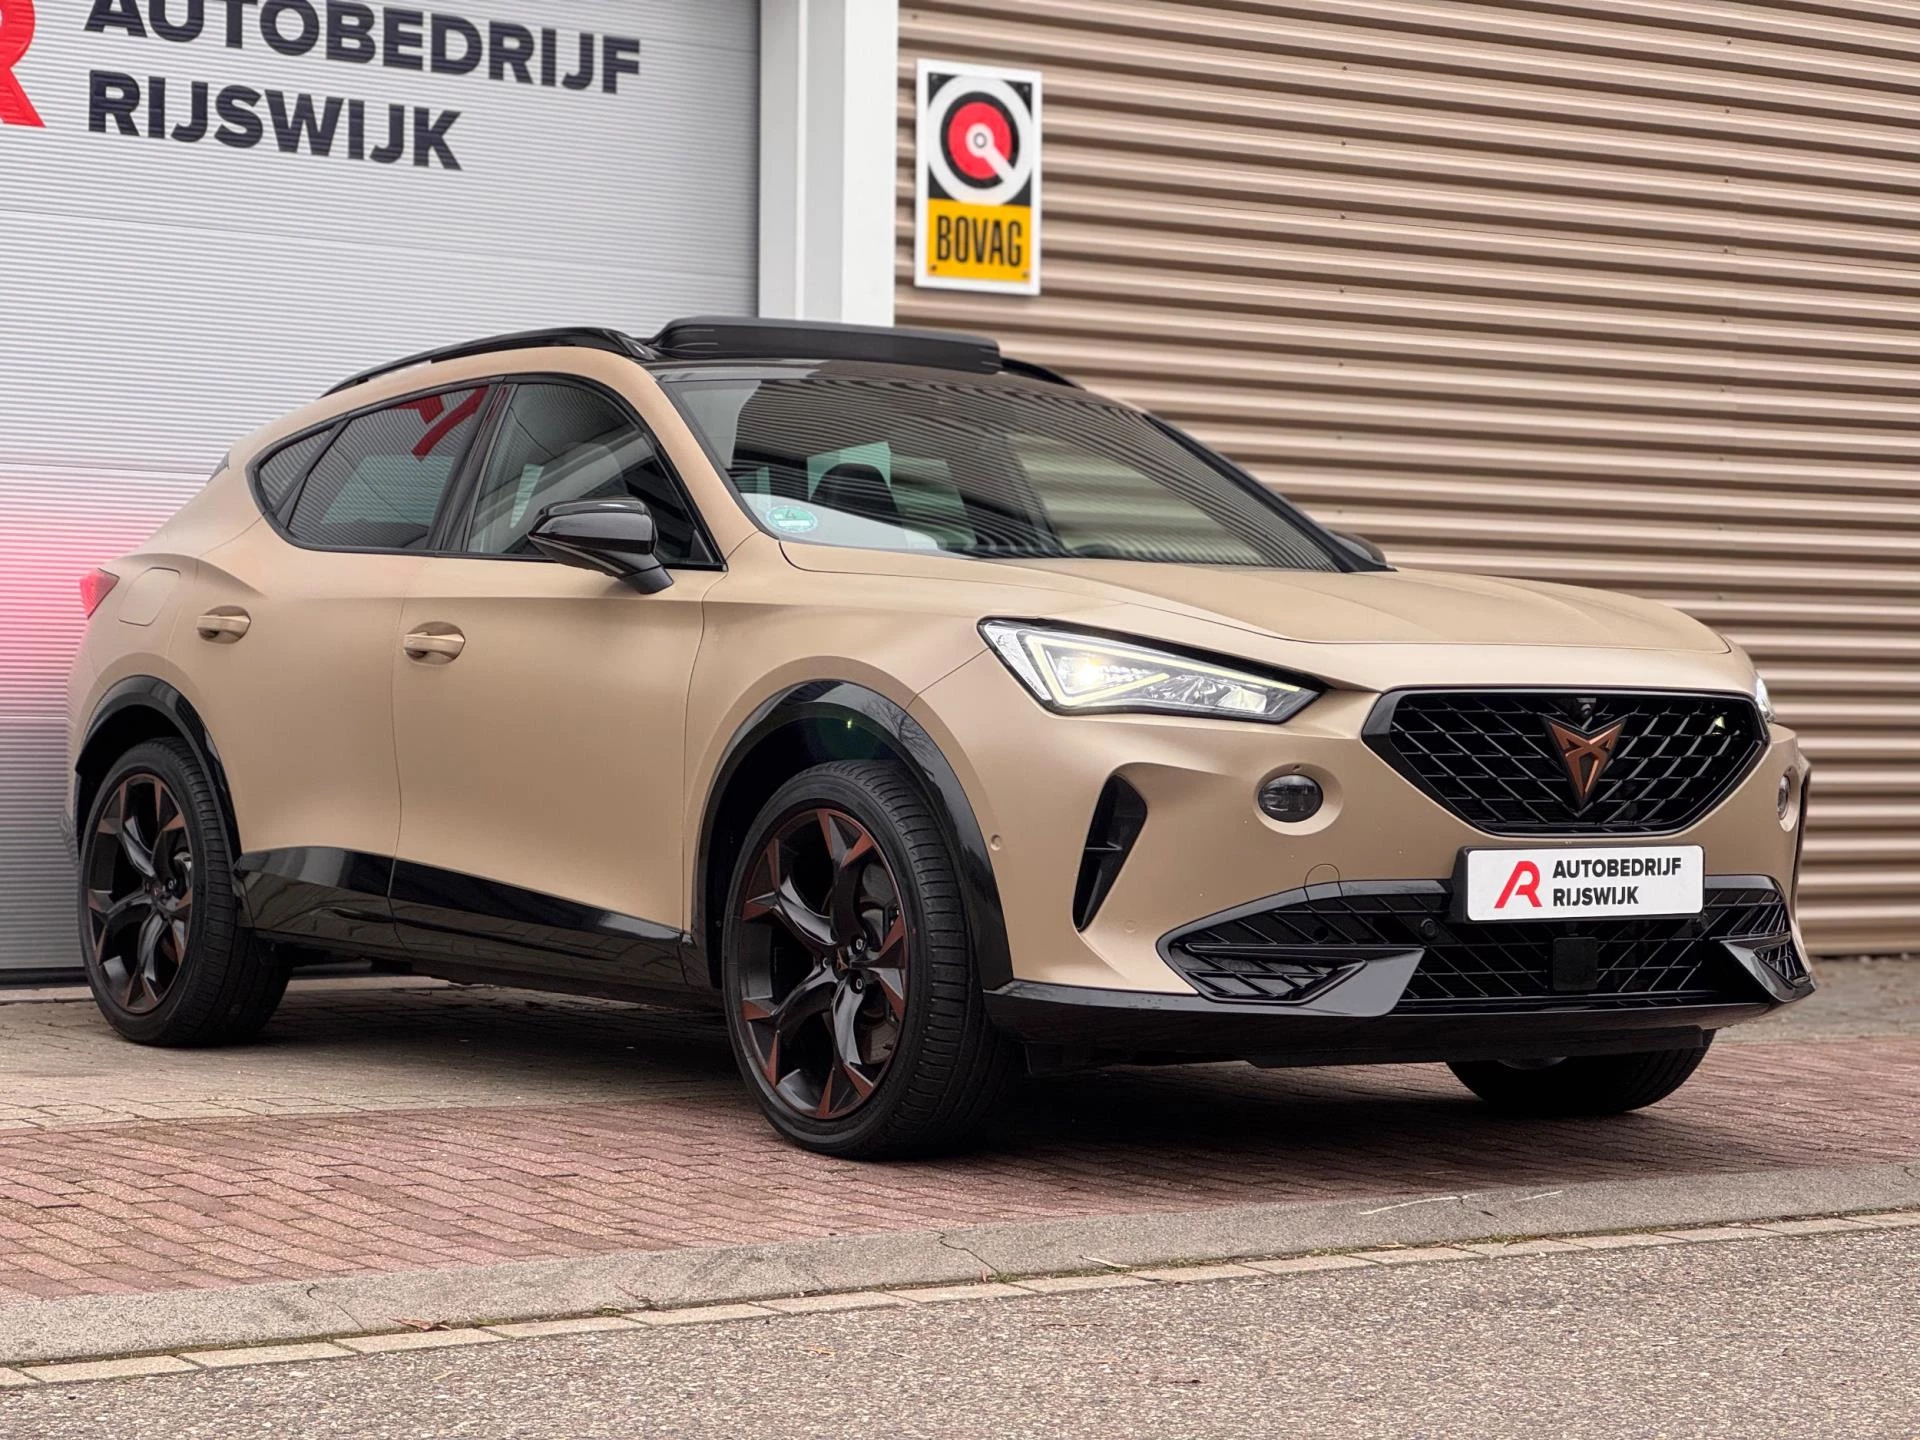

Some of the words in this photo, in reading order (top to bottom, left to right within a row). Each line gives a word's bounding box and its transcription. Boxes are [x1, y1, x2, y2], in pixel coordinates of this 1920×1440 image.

[84, 0, 640, 94] AUTOBEDRIJF
[88, 69, 462, 171] RIJSWIJK
[936, 215, 1022, 267] BOVAG
[1552, 857, 1682, 878] AUTOBEDRIJF
[1553, 886, 1639, 906] RIJSWIJK
